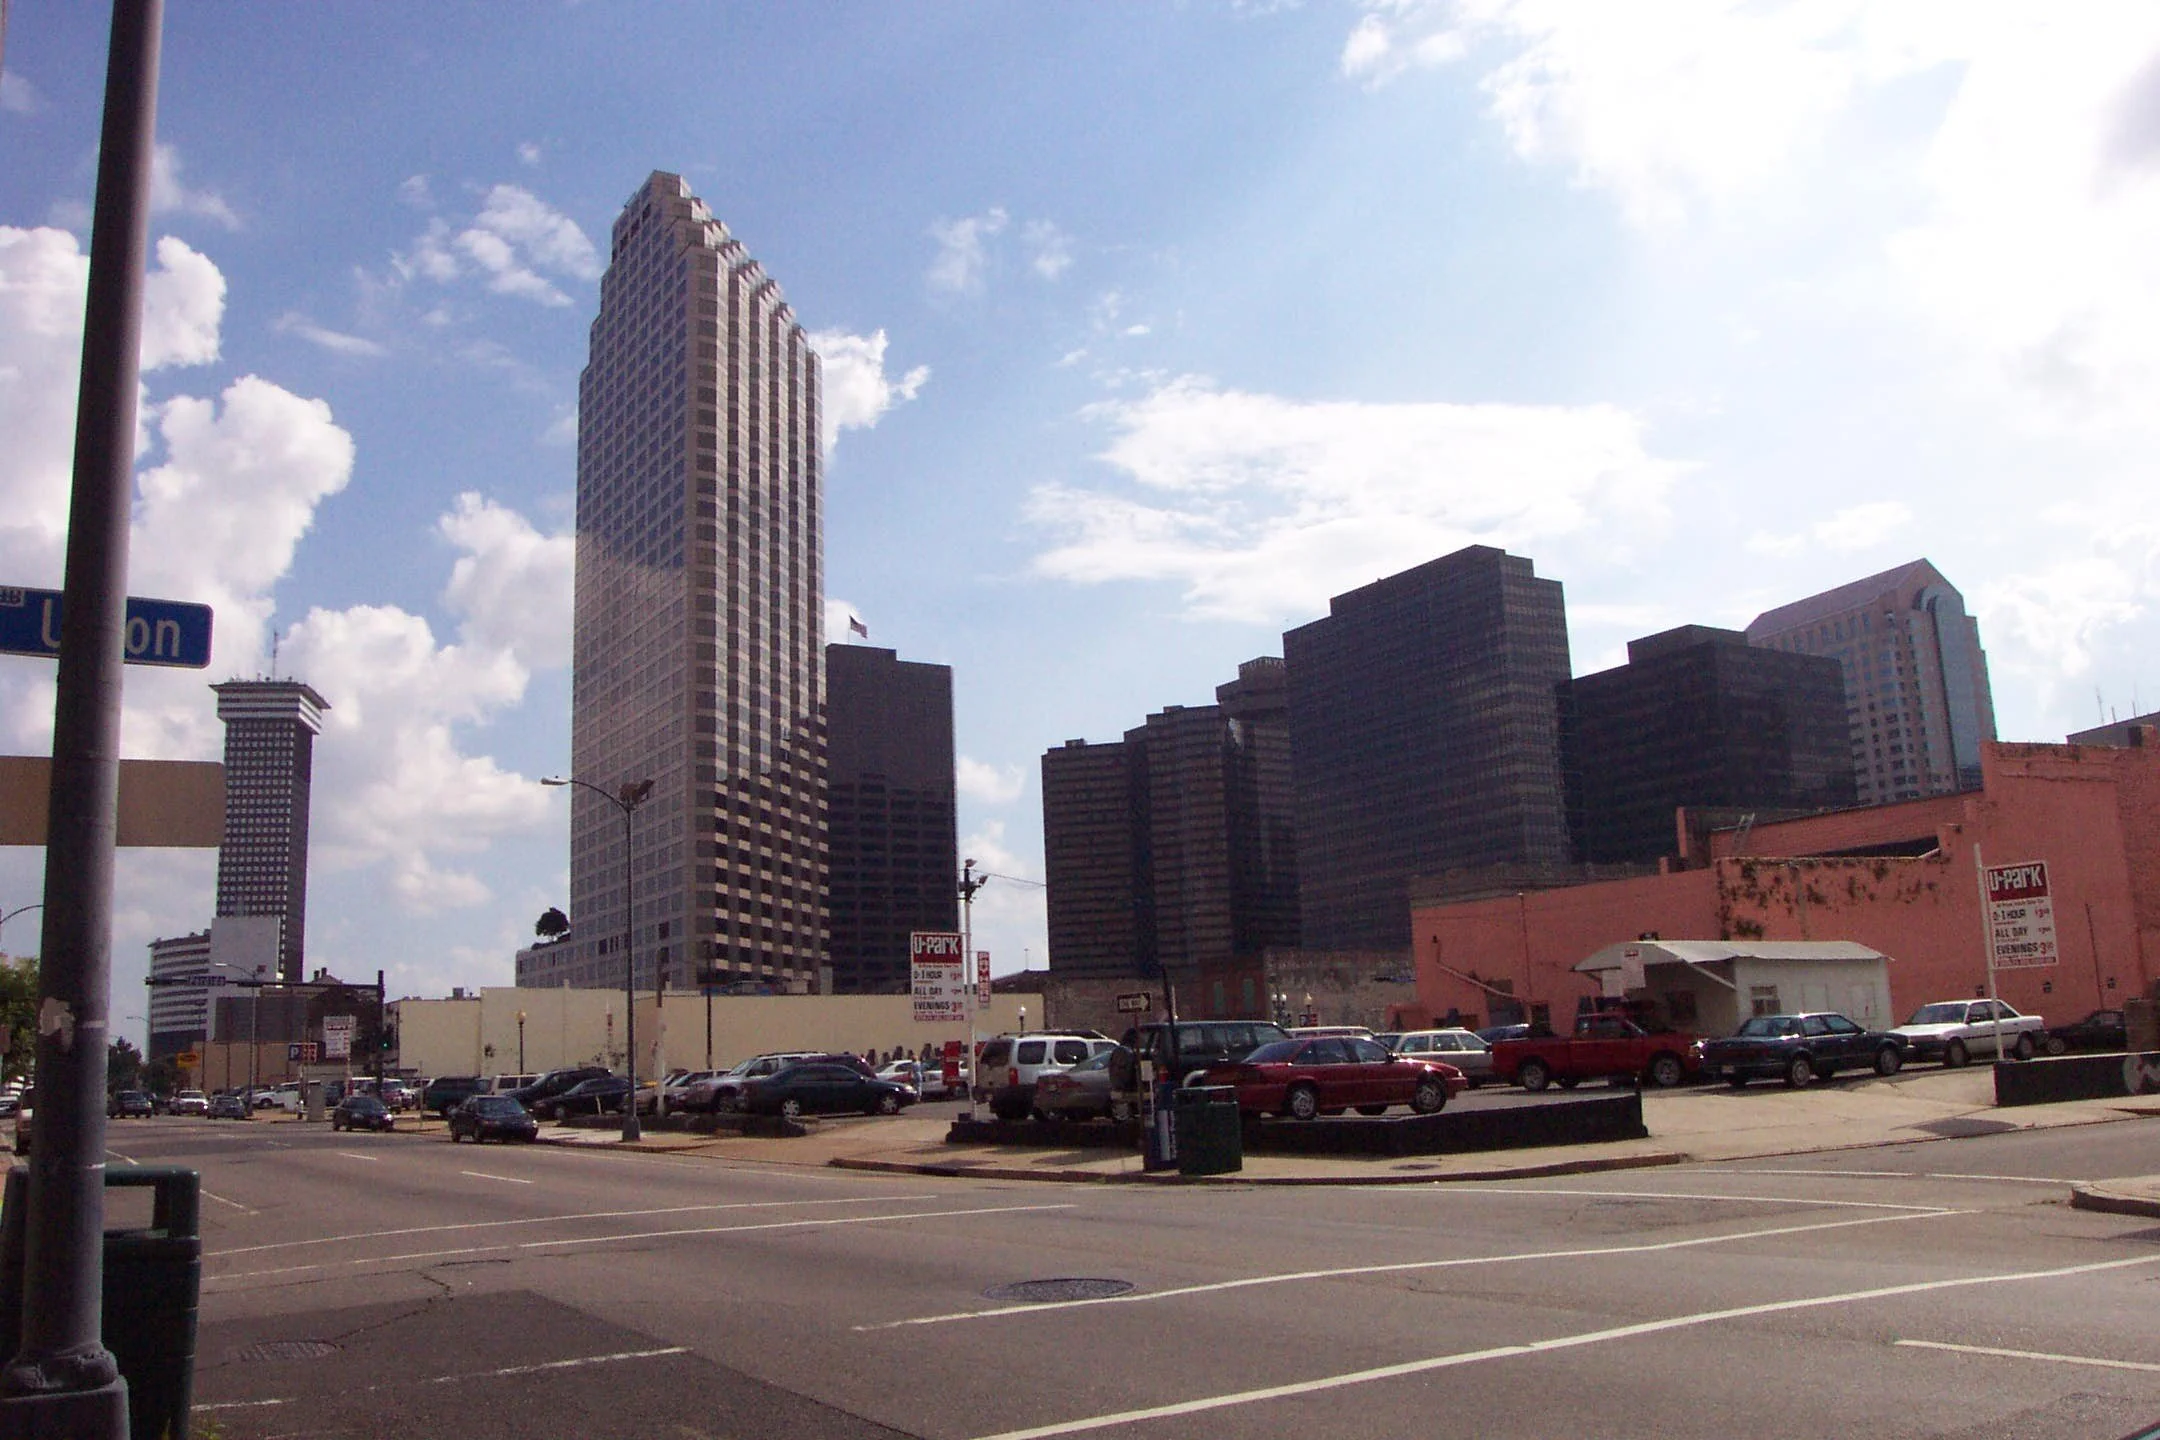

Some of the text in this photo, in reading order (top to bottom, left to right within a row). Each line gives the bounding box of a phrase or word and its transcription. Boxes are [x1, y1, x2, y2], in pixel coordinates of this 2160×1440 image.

[41, 599, 181, 657] Uon
[1995, 928, 2009, 938] ALL
[1996, 943, 2038, 955] EVENINGS
[914, 1001, 950, 1010] EVENINGS
